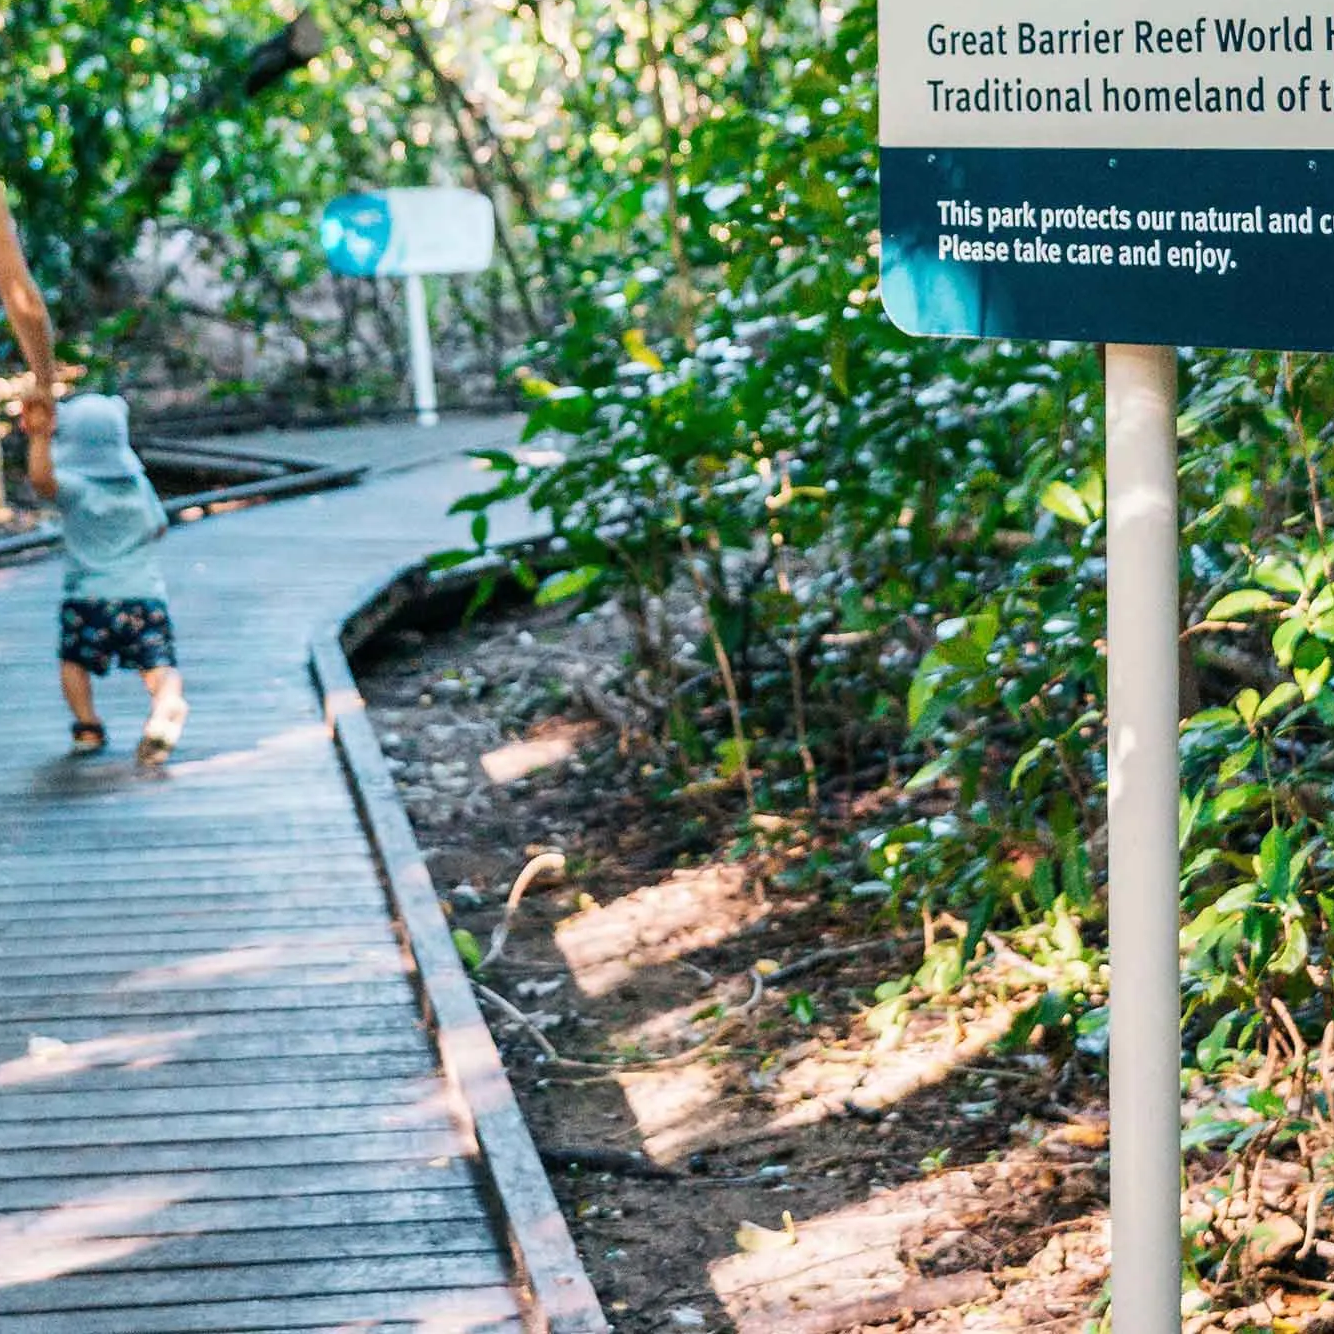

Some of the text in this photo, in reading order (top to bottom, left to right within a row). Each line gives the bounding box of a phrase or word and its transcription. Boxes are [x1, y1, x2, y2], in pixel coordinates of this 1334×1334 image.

[927, 23, 1008, 56] Great
[1018, 19, 1124, 55] Barrier
[1135, 17, 1207, 54] Reef
[1214, 15, 1313, 53] World
[927, 77, 1093, 113] Traditional
[1102, 76, 1265, 113] homeland
[1277, 75, 1311, 112] of
[936, 199, 983, 227] This
[987, 200, 1037, 233] park
[1041, 204, 1132, 235] protects
[1136, 210, 1176, 231] our
[1180, 205, 1264, 233] natural
[1268, 206, 1313, 235] and
[938, 234, 1237, 275] Please take care and enjoy.
